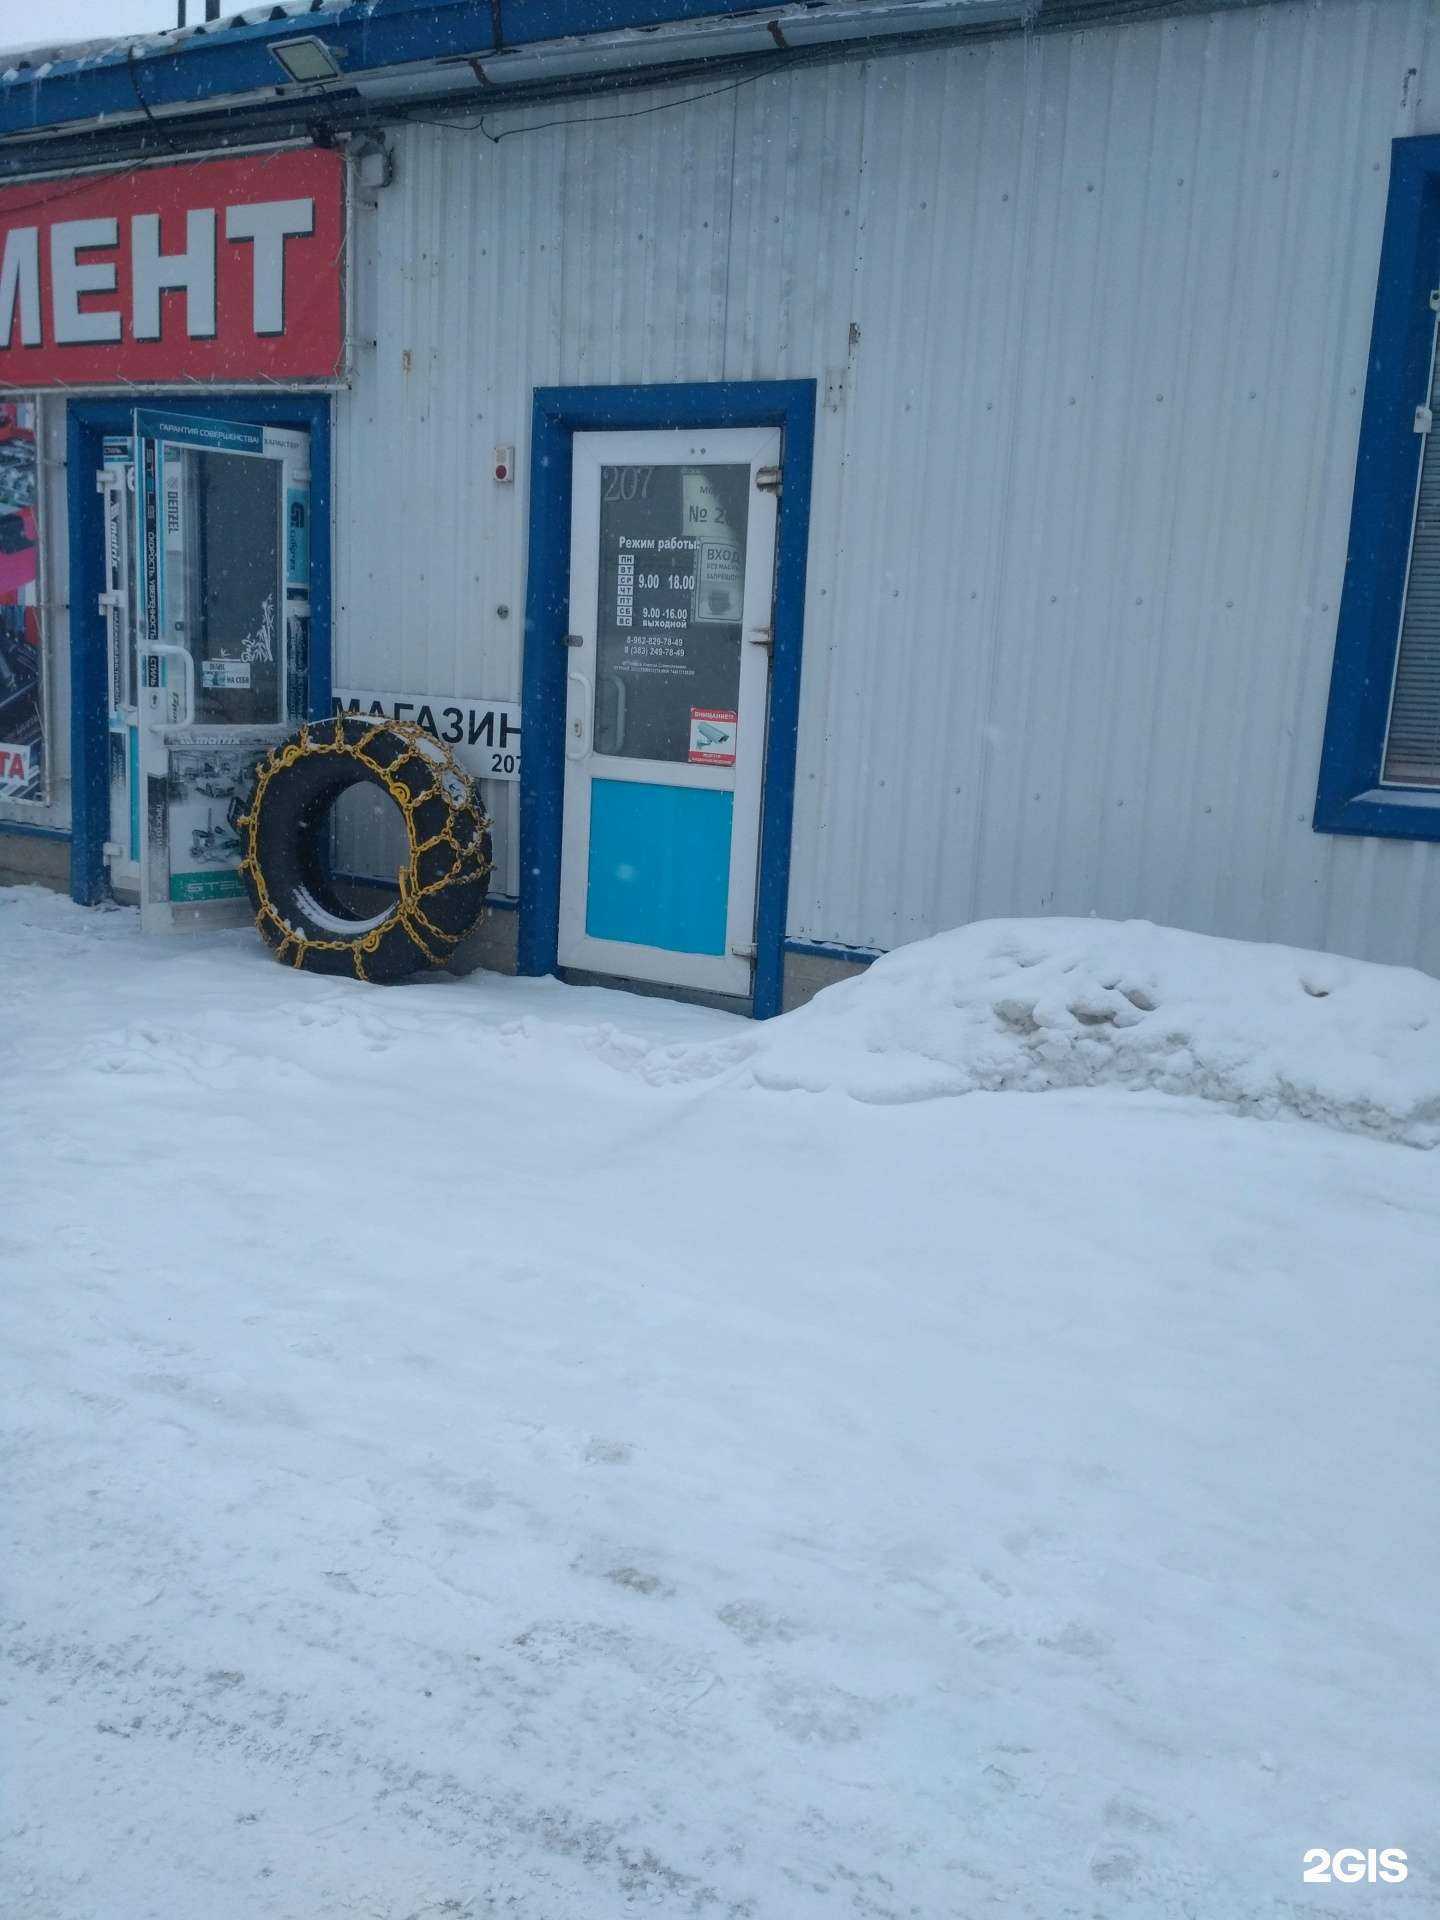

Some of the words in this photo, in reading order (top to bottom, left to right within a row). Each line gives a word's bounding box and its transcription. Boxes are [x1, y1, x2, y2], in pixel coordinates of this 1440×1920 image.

[619, 536, 655, 549] Режим
[620, 555, 633, 563] ПН
[707, 549, 740, 563] ВХОД
[620, 565, 633, 574] ВТ
[619, 576, 633, 584] СР
[638, 574, 659, 589] 9.00
[619, 586, 632, 595] ЧТ
[618, 596, 632, 605] ПТ
